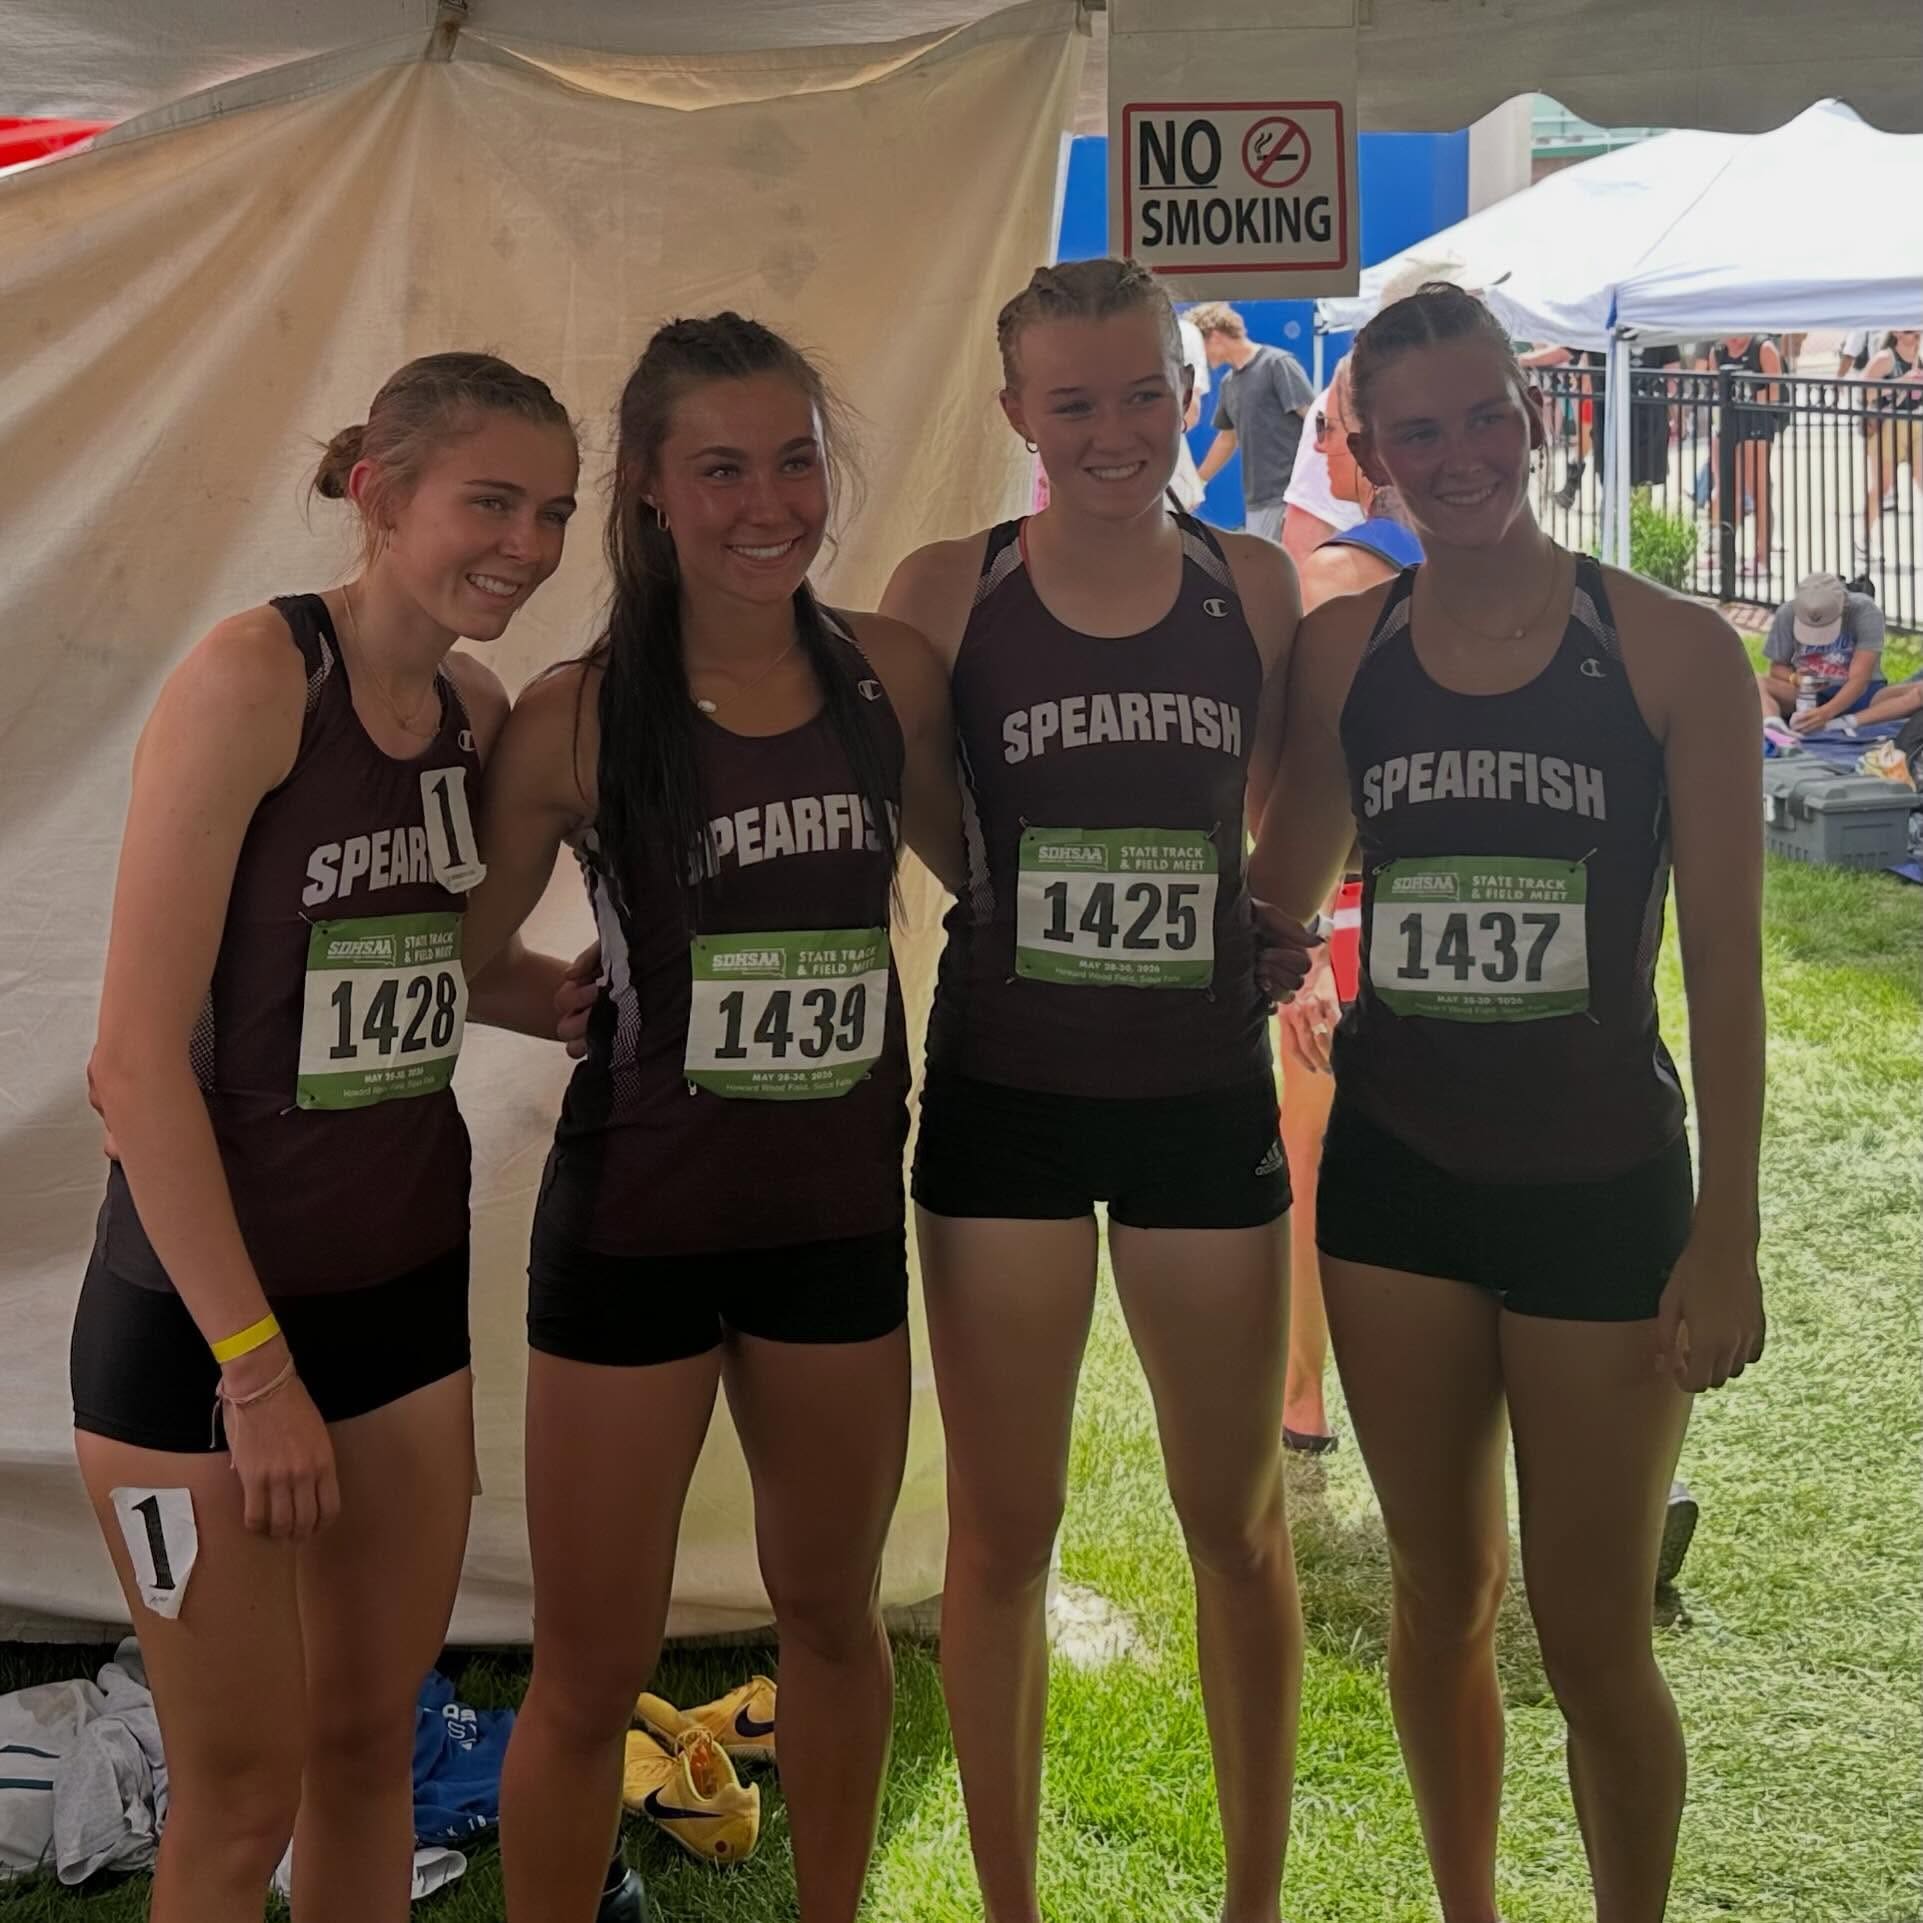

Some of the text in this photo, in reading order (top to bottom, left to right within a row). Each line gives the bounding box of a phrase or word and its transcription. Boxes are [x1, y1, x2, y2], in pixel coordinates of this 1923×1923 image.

[1139, 119, 1222, 185] NO
[1141, 196, 1331, 246] SMOKING
[1002, 692, 1241, 765] SPEARFISH
[1363, 750, 1606, 821] SPEARFISH
[431, 776, 467, 869] 1
[677, 793, 899, 888] PEARFI
[302, 826, 433, 907] SPEAR
[1038, 846, 1103, 859] SDHSAA
[1120, 846, 1203, 858] STATE TRACK
[1120, 859, 1205, 871] & FIELD MEET
[1471, 888, 1568, 901] & FIELD MEET
[1472, 875, 1566, 890] STATE TRACK
[1043, 881, 1200, 951] 1425
[712, 952, 780, 967] SDHSAA
[797, 964, 807, 976] &
[813, 963, 847, 976] FIELD
[799, 945, 877, 962] STATE TRACK
[1079, 960, 1101, 969] MAY
[1397, 911, 1561, 982] 1437
[330, 971, 457, 1059] 1428
[715, 983, 866, 1059] 1439
[364, 1073, 383, 1084] MAY
[752, 1071, 774, 1082] MAY
[131, 1495, 176, 1590] 1
